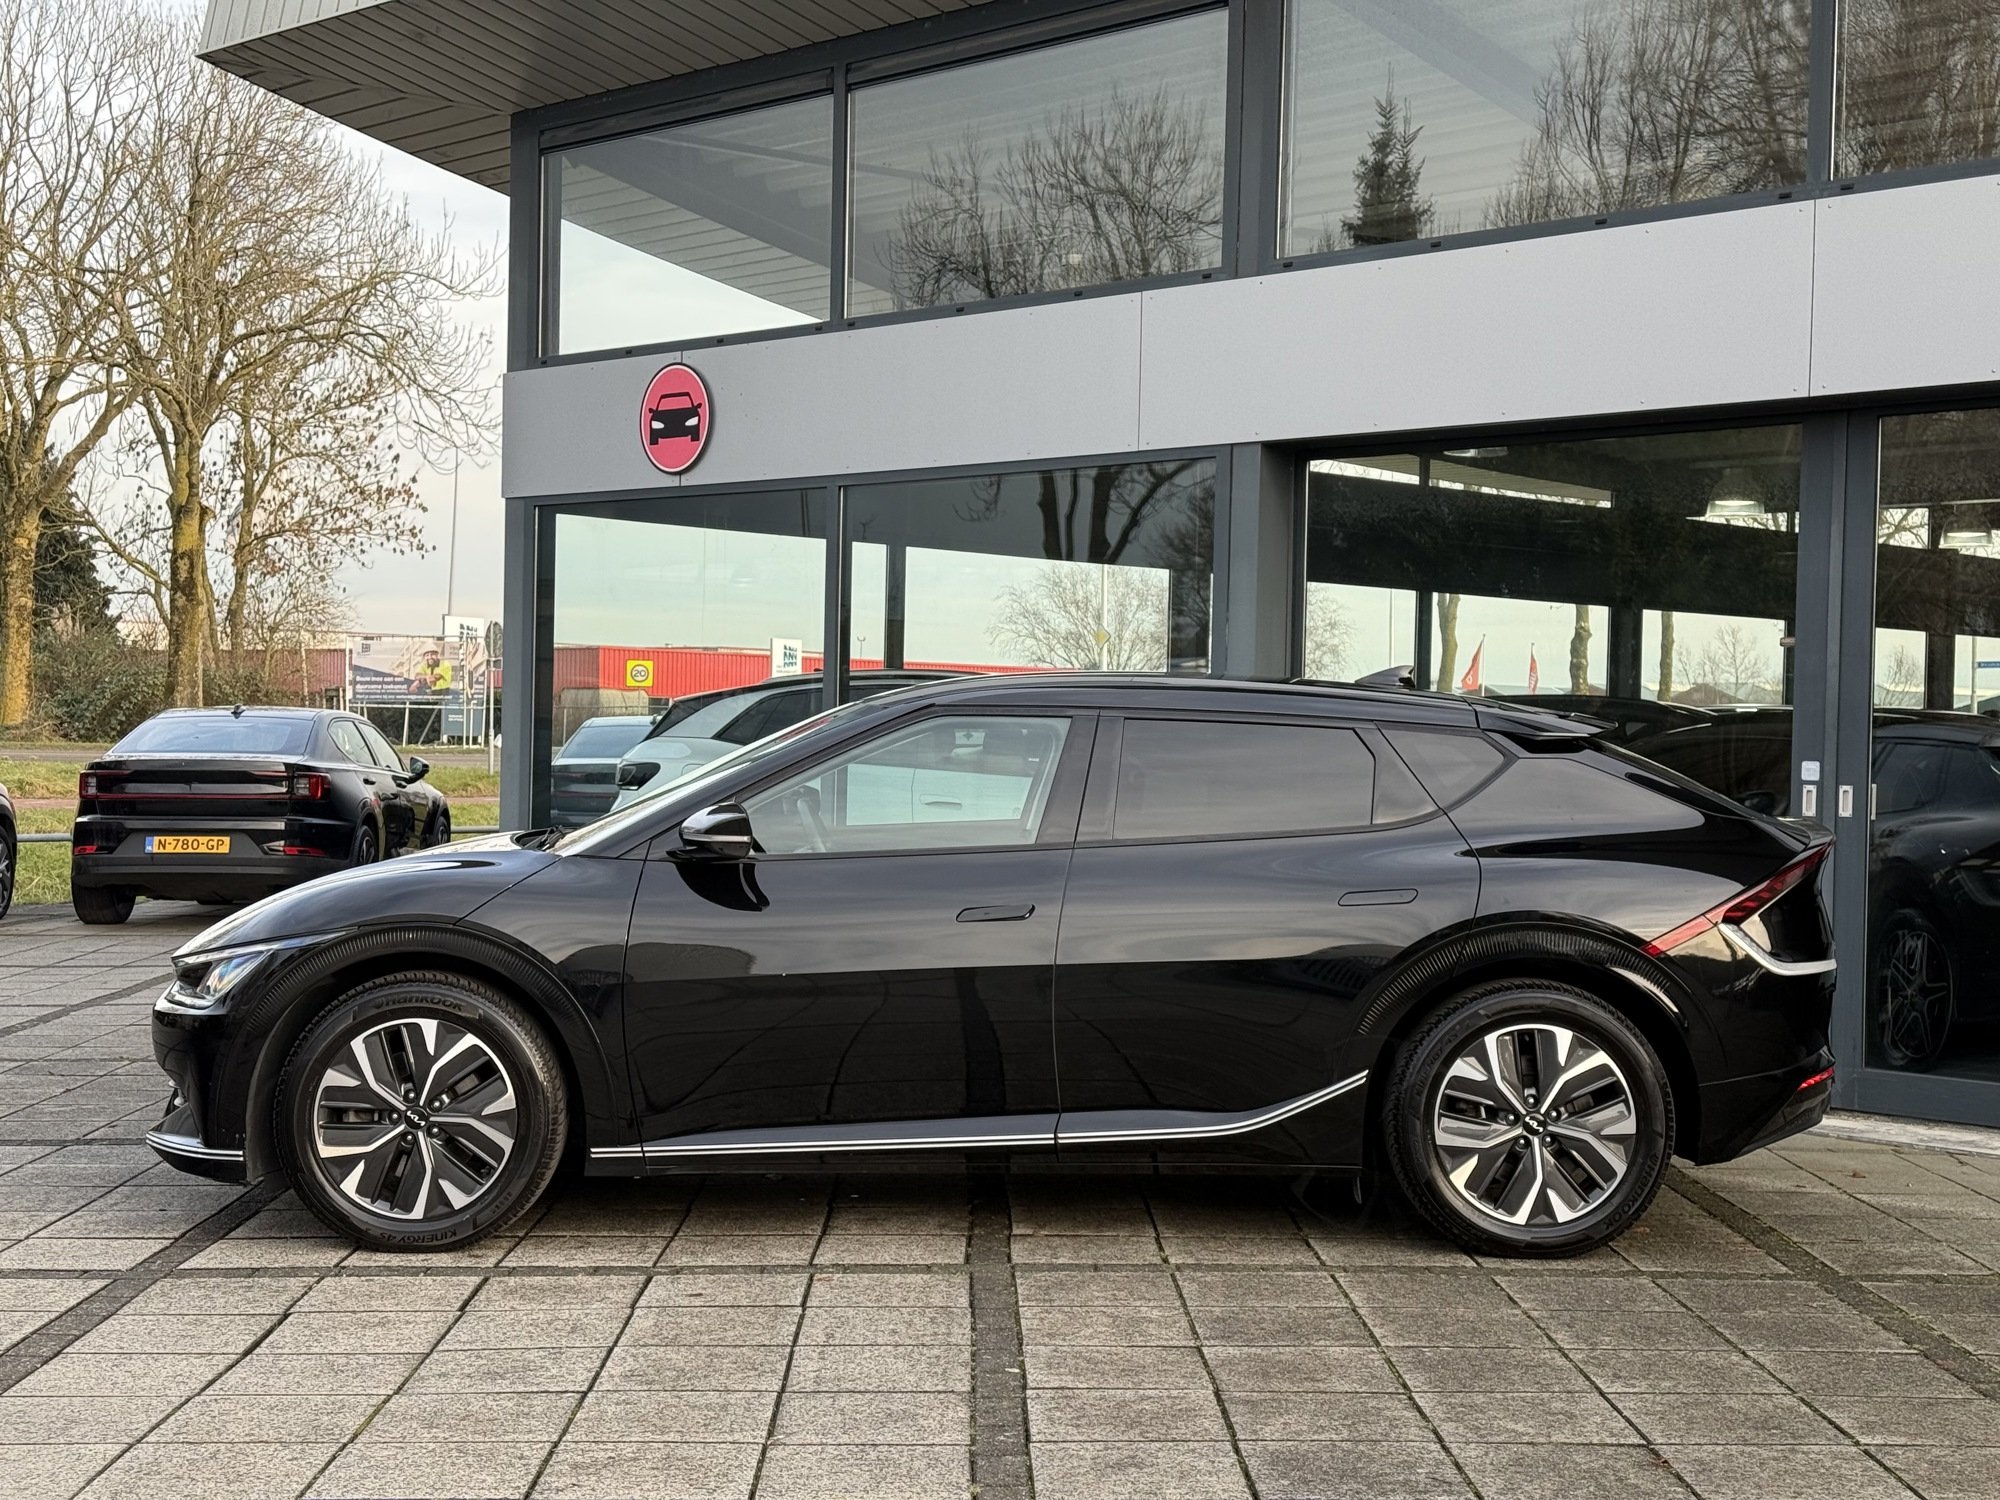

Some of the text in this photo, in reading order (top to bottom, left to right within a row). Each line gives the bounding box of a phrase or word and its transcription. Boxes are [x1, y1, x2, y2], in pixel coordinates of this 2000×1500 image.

[634, 669, 646, 677] 20
[157, 838, 225, 851] N-780-GP
[398, 1229, 457, 1244] KINERGY
